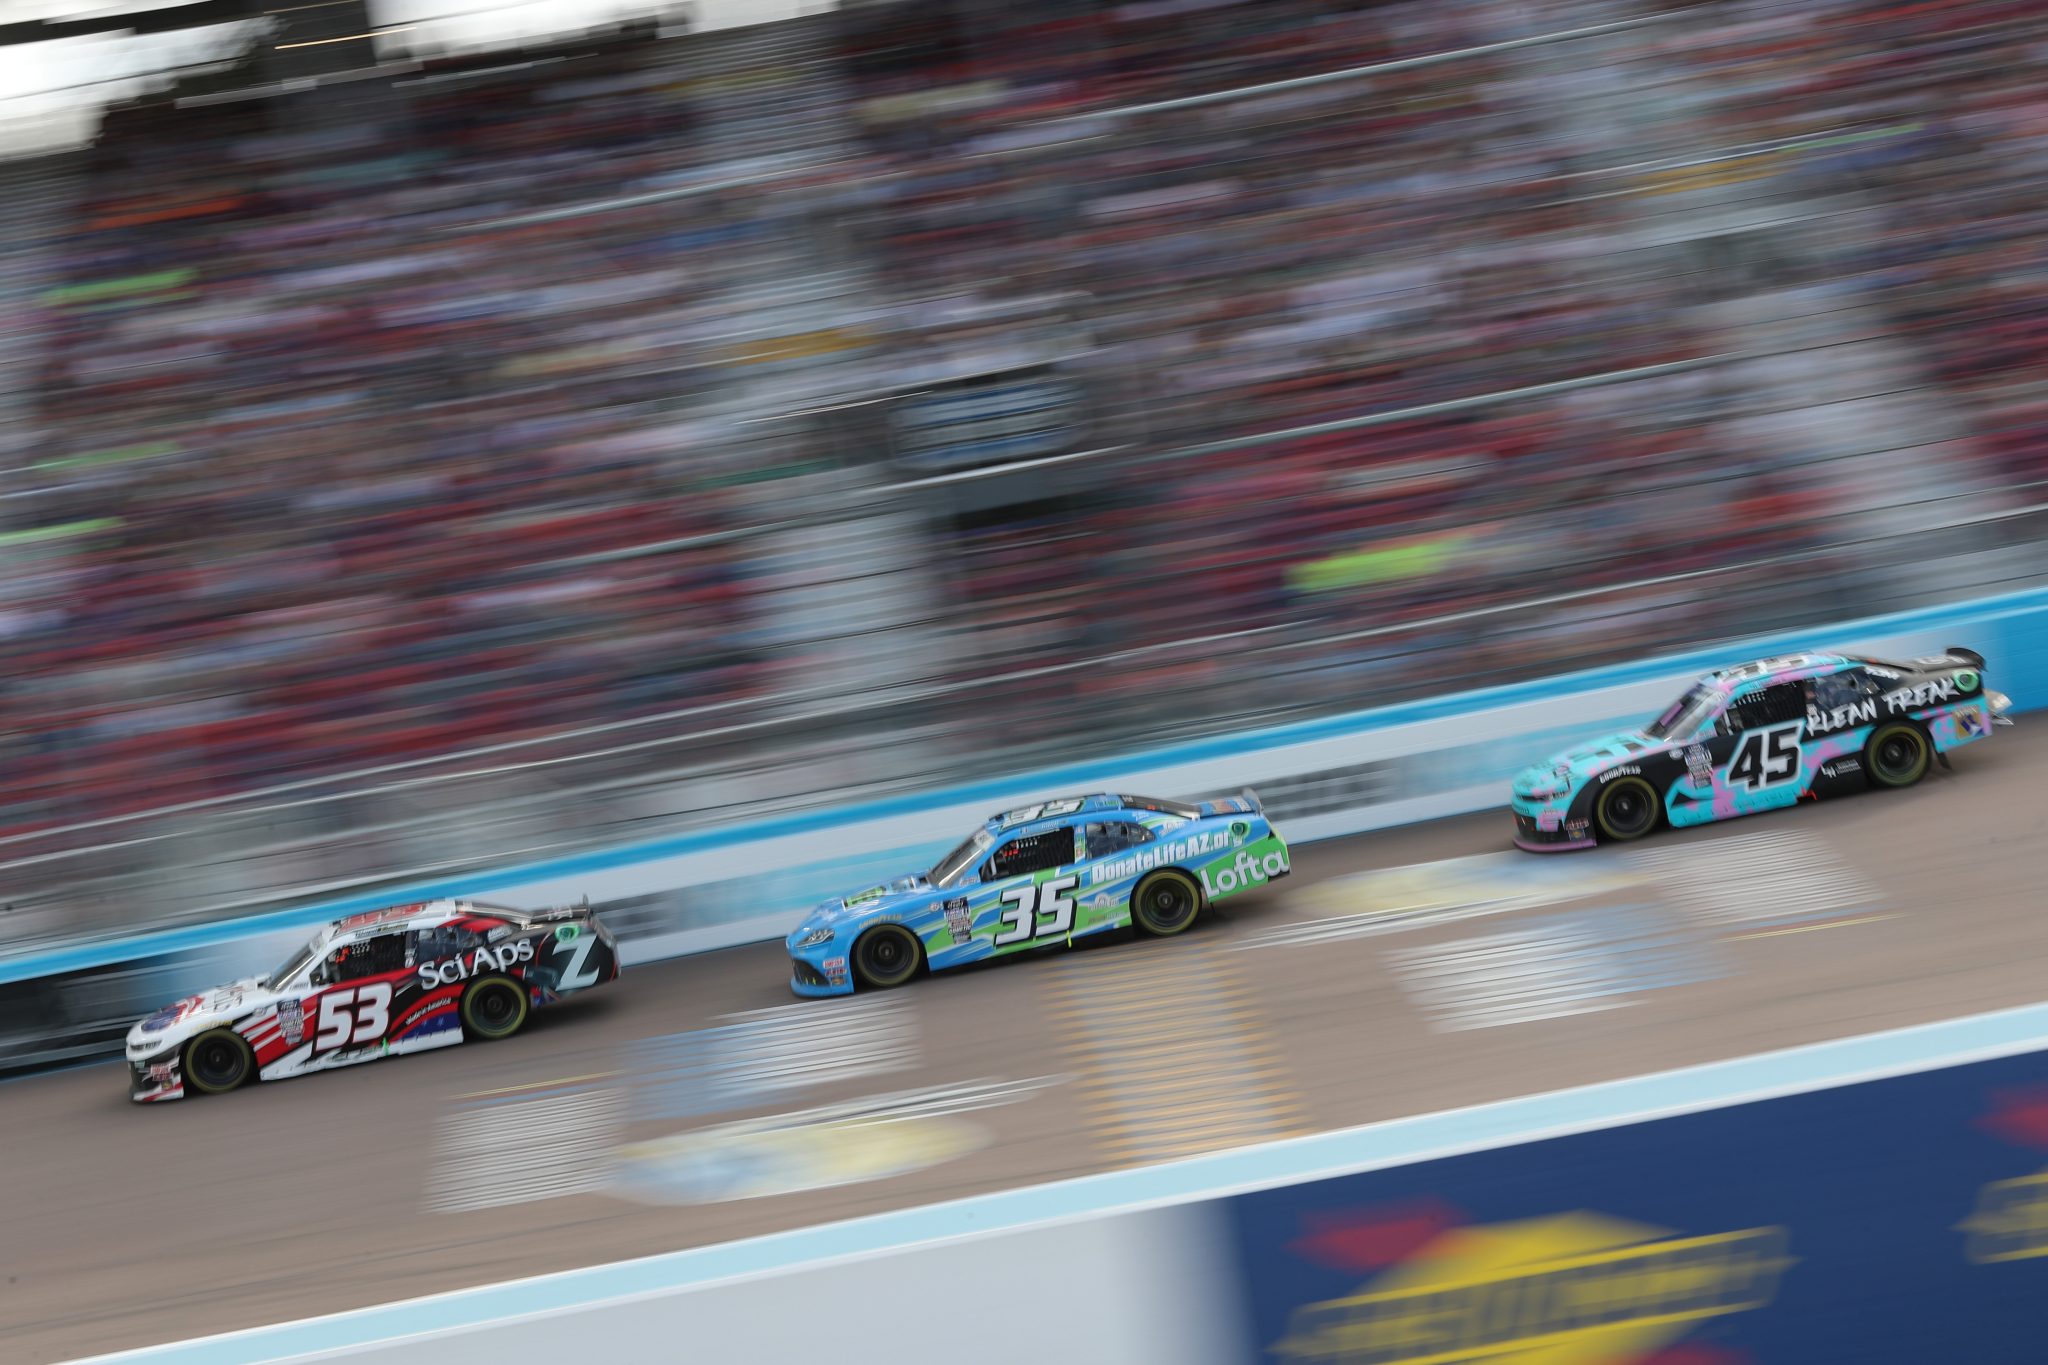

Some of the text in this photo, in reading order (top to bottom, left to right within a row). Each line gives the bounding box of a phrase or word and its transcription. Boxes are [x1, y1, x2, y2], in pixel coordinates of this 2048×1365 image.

[1805, 677, 1960, 737] KLEAN FREAK
[1727, 719, 1805, 793] 45
[1200, 850, 1290, 898] Lofta
[994, 874, 1080, 948] 35
[316, 983, 392, 1051] 53
